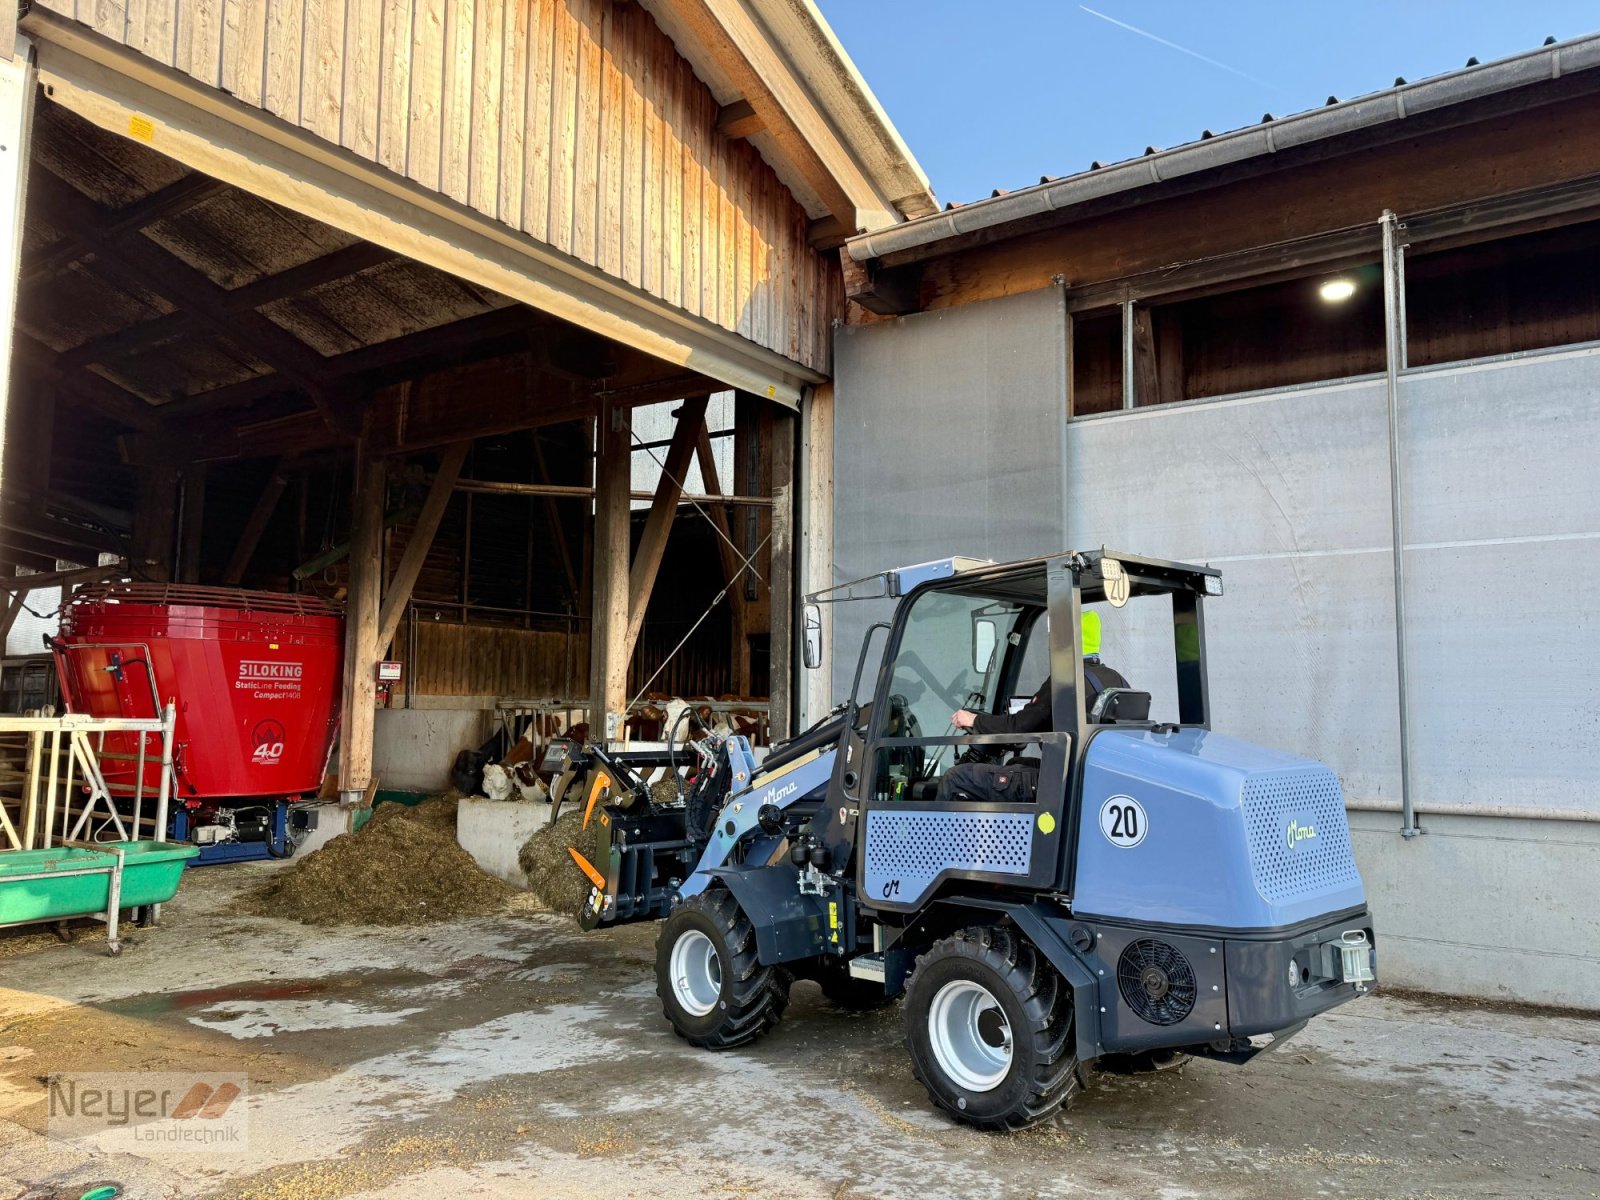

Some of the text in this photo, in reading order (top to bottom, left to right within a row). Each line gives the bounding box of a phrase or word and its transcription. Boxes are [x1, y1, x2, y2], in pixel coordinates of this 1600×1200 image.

[239, 664, 303, 677] SILOKING
[235, 681, 302, 691] StaticLine Feeding
[1109, 804, 1138, 838] 20
